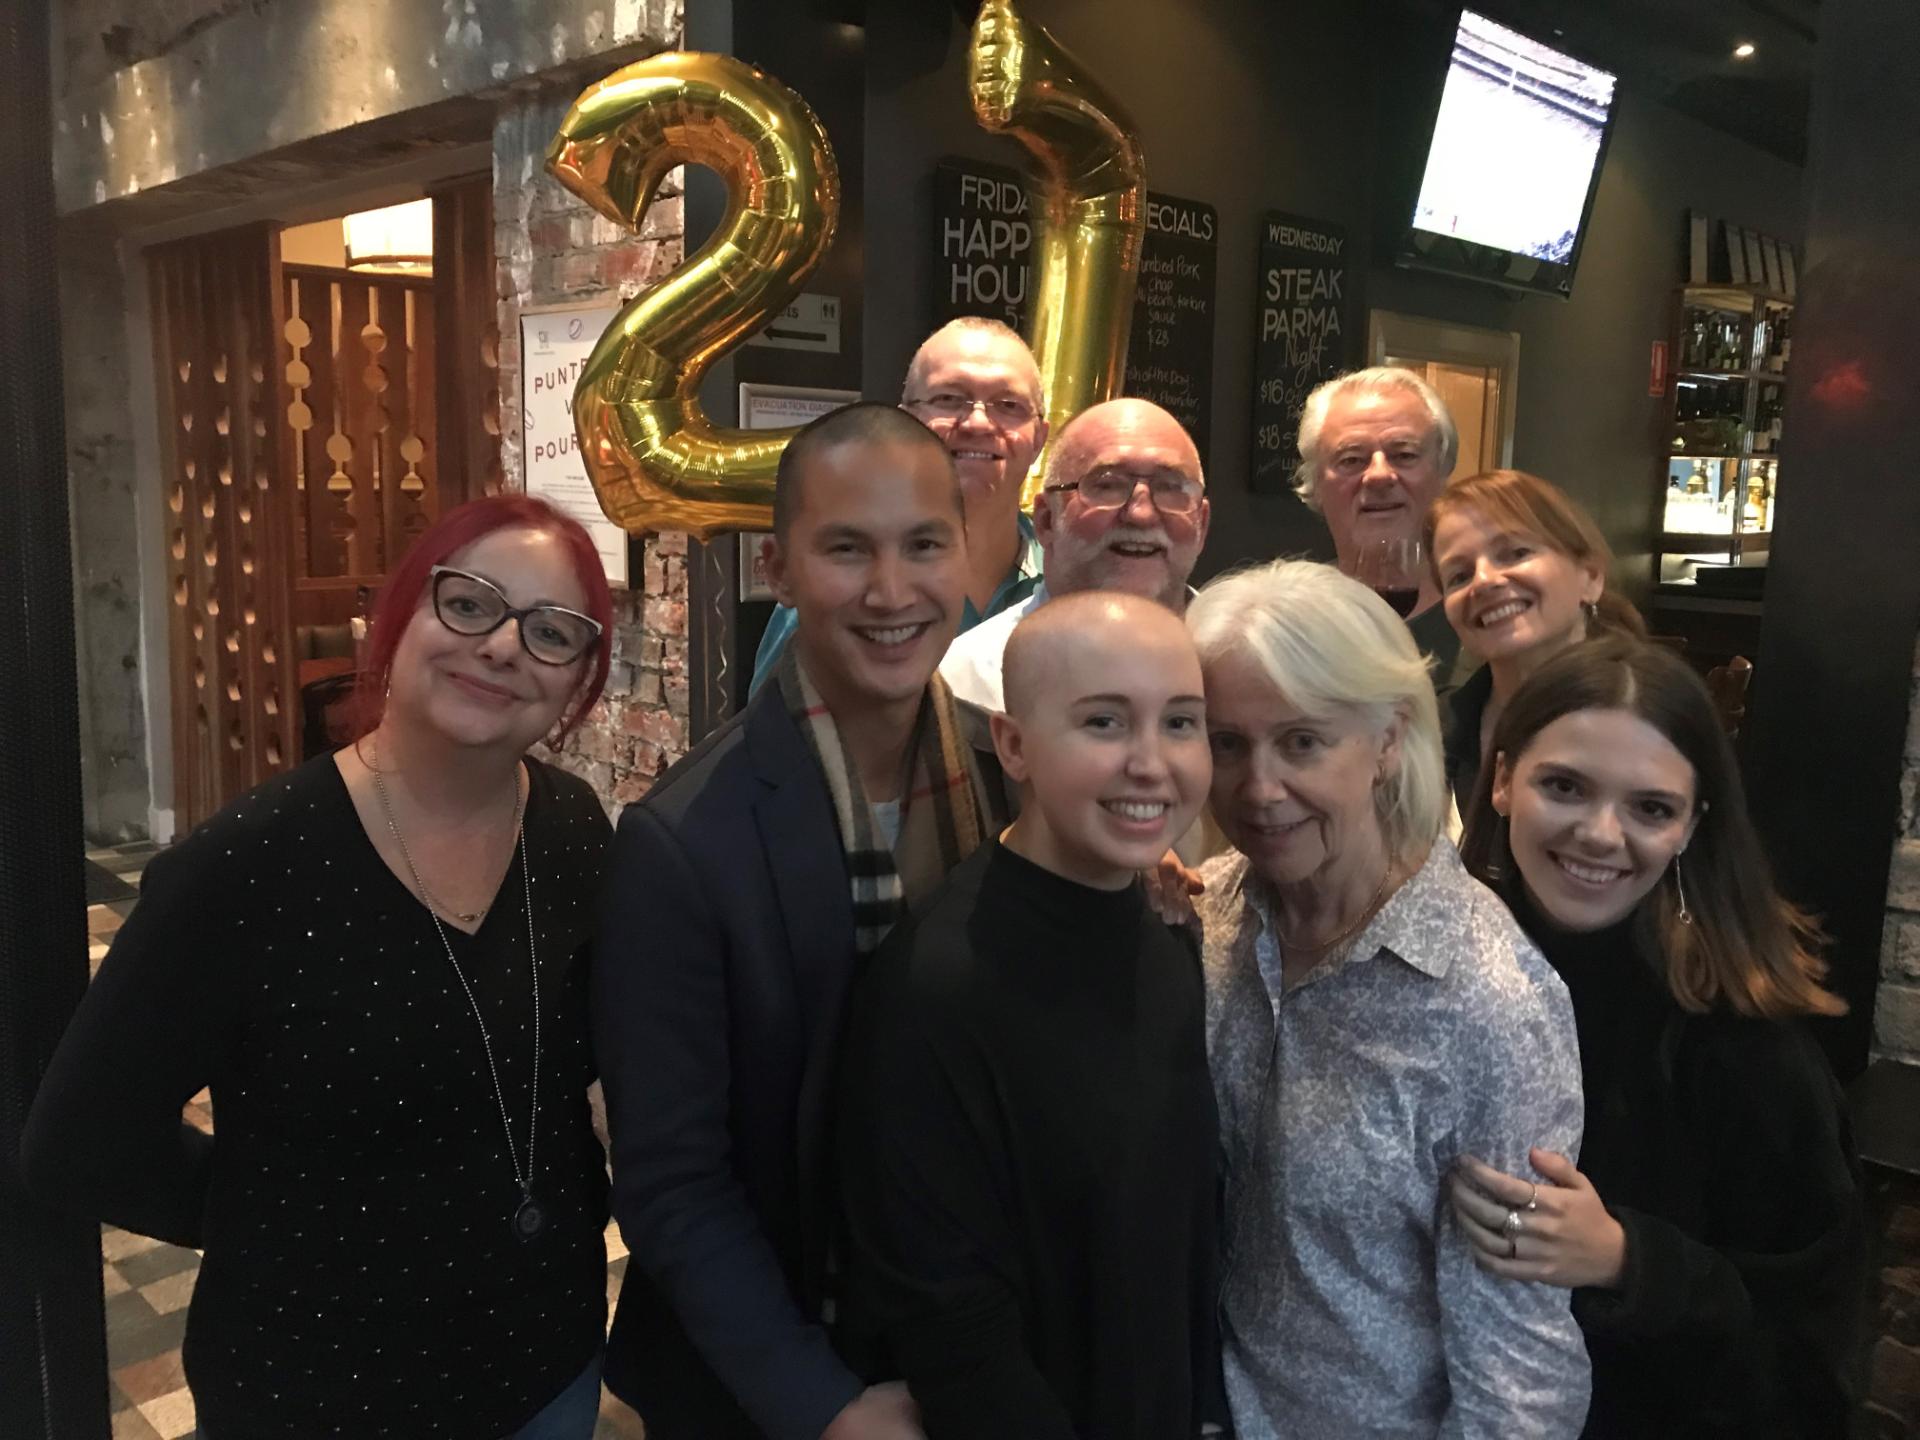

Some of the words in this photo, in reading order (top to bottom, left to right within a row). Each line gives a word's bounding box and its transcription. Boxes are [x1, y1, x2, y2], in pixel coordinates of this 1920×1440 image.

[961, 174, 1028, 214] FRIDA
[943, 217, 1032, 260] HAPP
[1147, 202, 1213, 240] ECIALS
[1268, 223, 1344, 256] WEDNESDAY
[1266, 269, 1343, 302] STEAK
[1263, 306, 1341, 342] PARMA
[1283, 334, 1329, 388] Night
[534, 433, 580, 463] POUR
